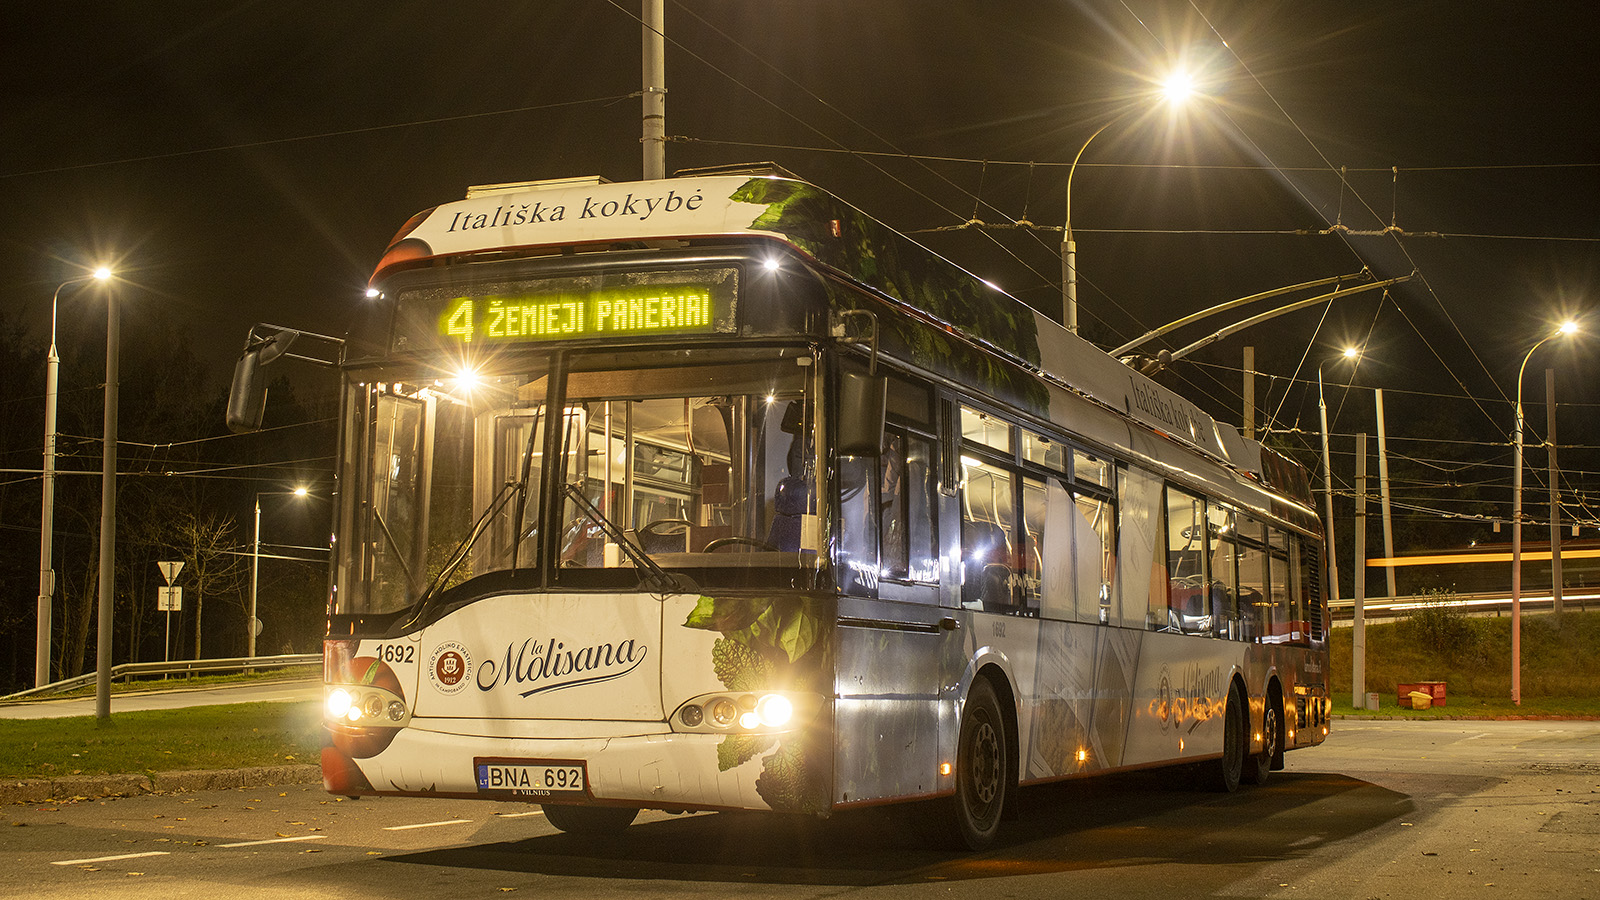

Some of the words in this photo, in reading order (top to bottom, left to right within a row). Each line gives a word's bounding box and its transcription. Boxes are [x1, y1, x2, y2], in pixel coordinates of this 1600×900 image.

[447, 202, 565, 233] Itališka
[578, 189, 704, 221] kokybė
[447, 300, 474, 342] 4
[488, 300, 584, 337] ŽEMIEJI
[597, 294, 709, 331] PANERIAI
[376, 644, 415, 663] 1692
[531, 640, 544, 655] la
[476, 637, 648, 692] Molisana
[444, 676, 457, 684] 1912
[491, 768, 531, 787] BNA
[544, 768, 580, 788] 692
